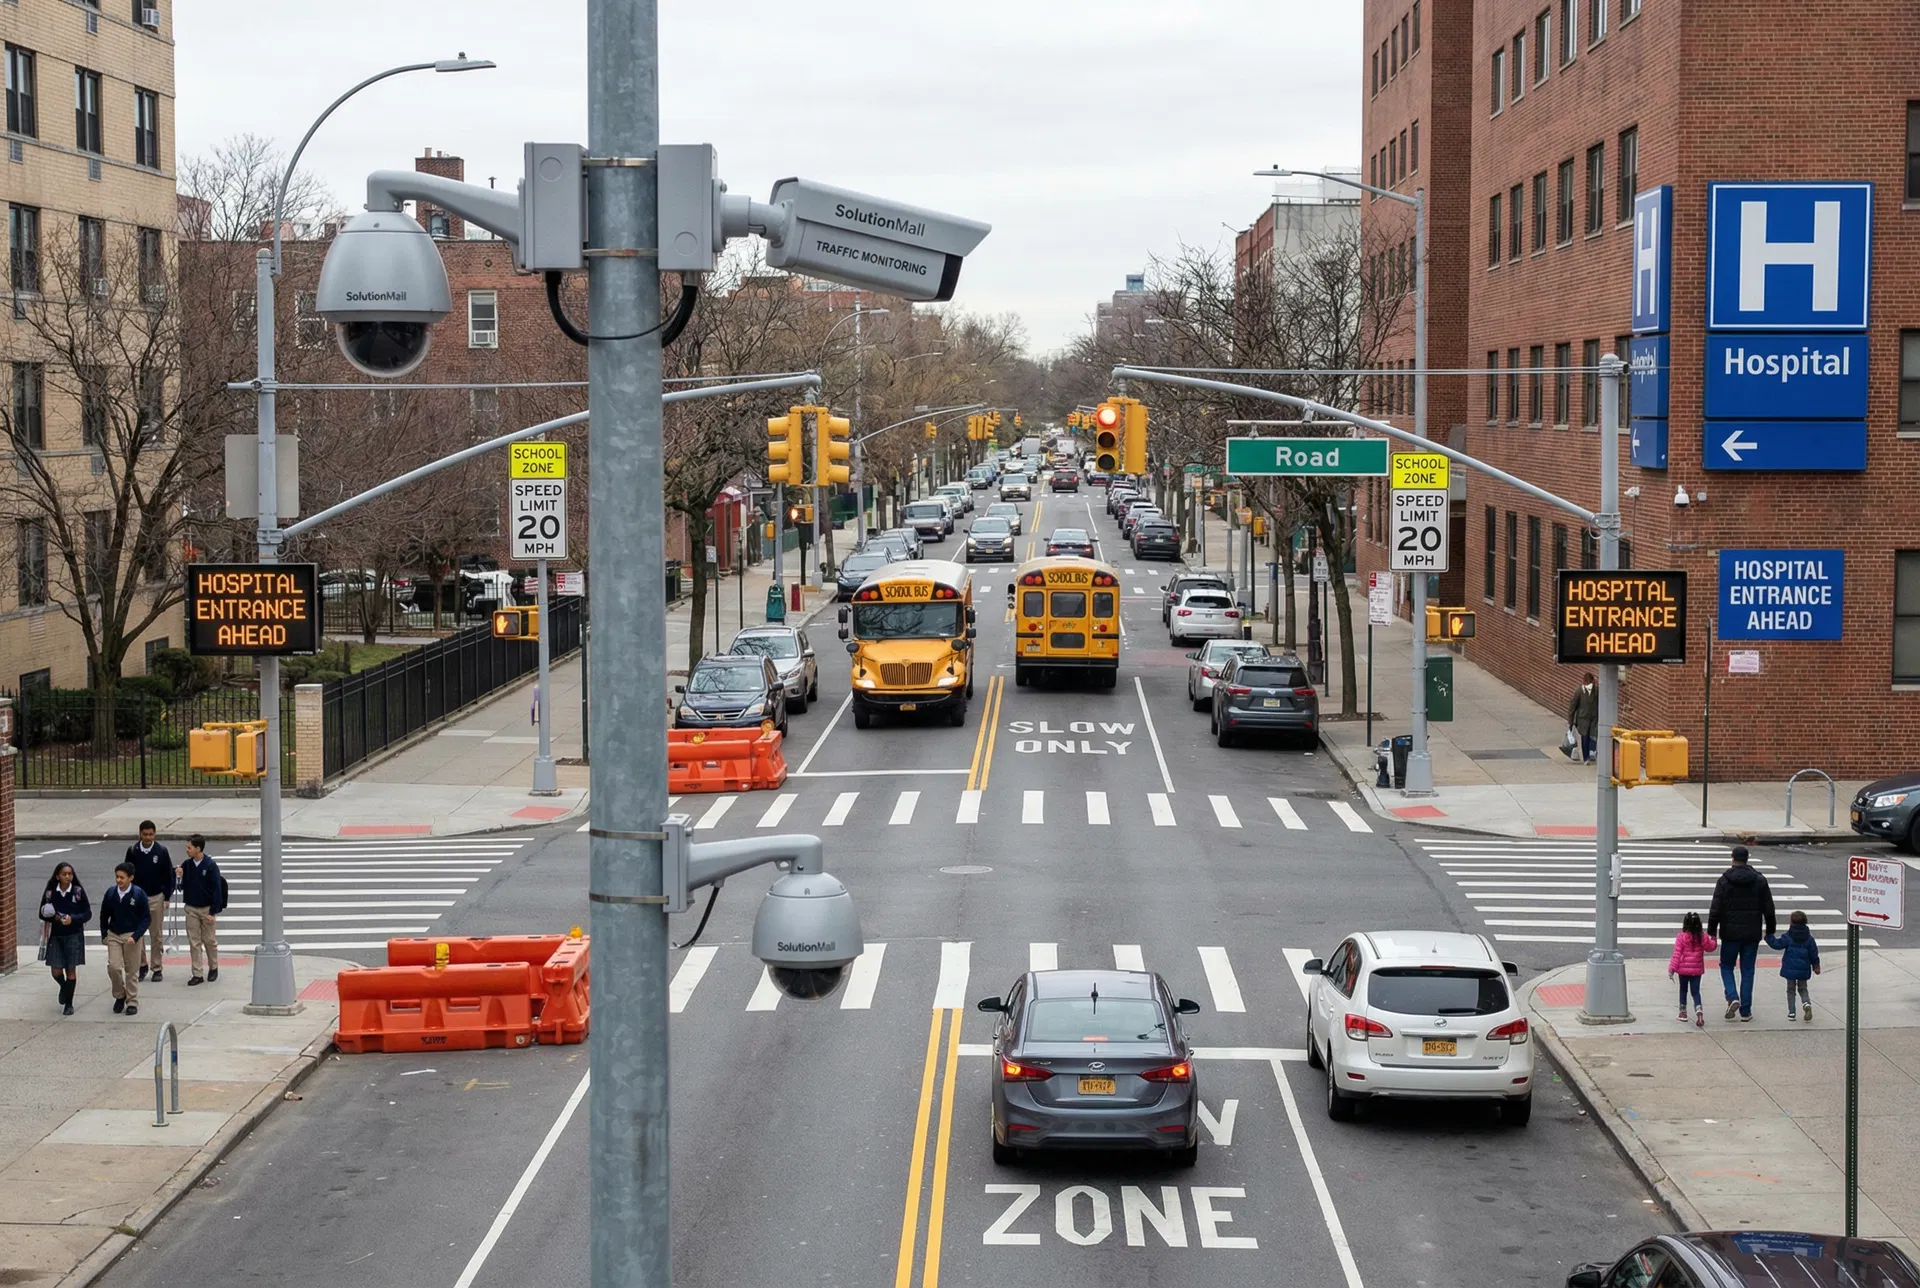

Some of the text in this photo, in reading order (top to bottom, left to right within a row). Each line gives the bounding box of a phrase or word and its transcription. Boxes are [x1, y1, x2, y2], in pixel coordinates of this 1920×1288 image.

[835, 204, 925, 236] SolutionMall
[816, 240, 927, 276] TRAFFIC MONITORING
[1636, 207, 1657, 316] H
[1739, 201, 1840, 312] H
[346, 291, 407, 301] SolutionMall
[1725, 347, 1849, 383] Hospital
[514, 448, 562, 459] SCHOOL
[1276, 446, 1340, 467] Road
[522, 463, 554, 473] ZONE
[1395, 458, 1445, 470] SCHOOL
[1403, 473, 1437, 484] ZONE
[515, 485, 562, 496] SPEED
[520, 500, 557, 511] LIMIT
[1395, 495, 1444, 507] SPEED
[1400, 510, 1439, 522] LIMIT
[518, 515, 560, 539] 20
[525, 543, 554, 554] MPH
[1397, 526, 1442, 551] 20
[1403, 555, 1435, 566] MPH
[1734, 560, 1829, 580] HOSPITAL
[198, 573, 303, 594] HOSPITAL
[1568, 580, 1675, 602] HOSPITAL
[1730, 585, 1832, 605] ENTRANCE
[197, 599, 306, 620] ENTRANCE
[1566, 606, 1677, 628] ENTRANCE
[1747, 611, 1812, 630] AHEAD
[218, 625, 286, 645] AHEAD
[1586, 632, 1656, 653] AHEAD
[1008, 721, 1135, 735] SLOW
[1015, 740, 1132, 755] ONLY
[1851, 861, 1866, 878] 30
[983, 1184, 1259, 1249] ZONE
